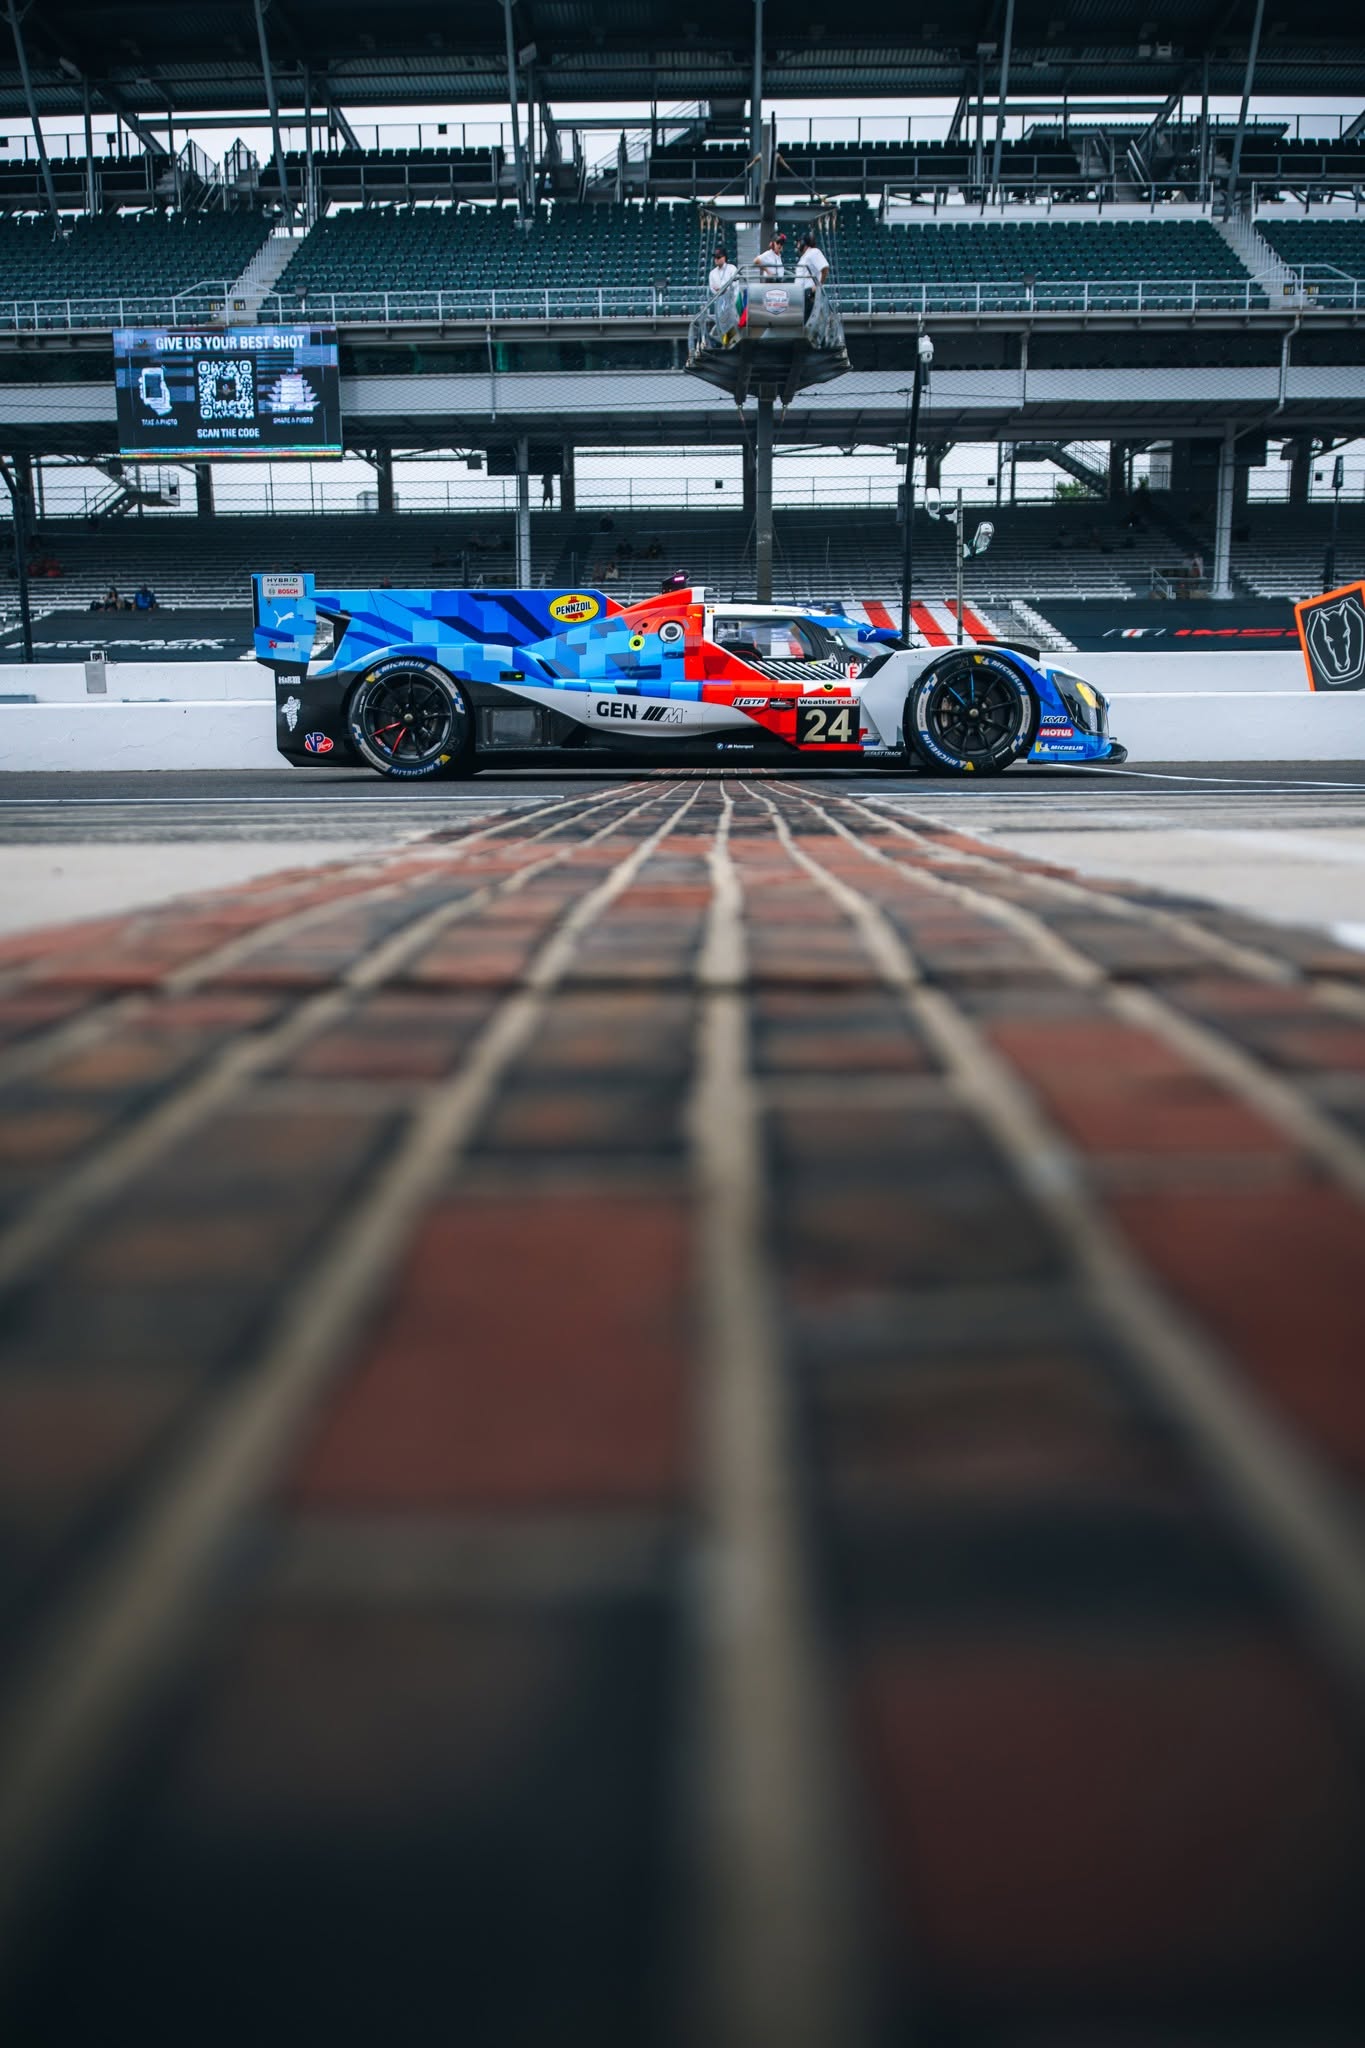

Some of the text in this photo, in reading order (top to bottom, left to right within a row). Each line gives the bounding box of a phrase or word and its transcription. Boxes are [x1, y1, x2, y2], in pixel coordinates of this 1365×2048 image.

[156, 335, 305, 350] GIVE US YOUR BEST SHOT
[197, 428, 260, 438] SCAN THE CODE
[556, 601, 592, 615] PENNZOIL
[381, 660, 425, 673] MICHELIN
[991, 660, 1026, 695] MICHELIN
[596, 701, 637, 720] GEN
[803, 709, 853, 742] 24
[1040, 729, 1073, 737] MOTUL
[305, 732, 325, 752] VP
[922, 733, 958, 765] MICHELIN
[392, 764, 435, 775] MICHELIN
